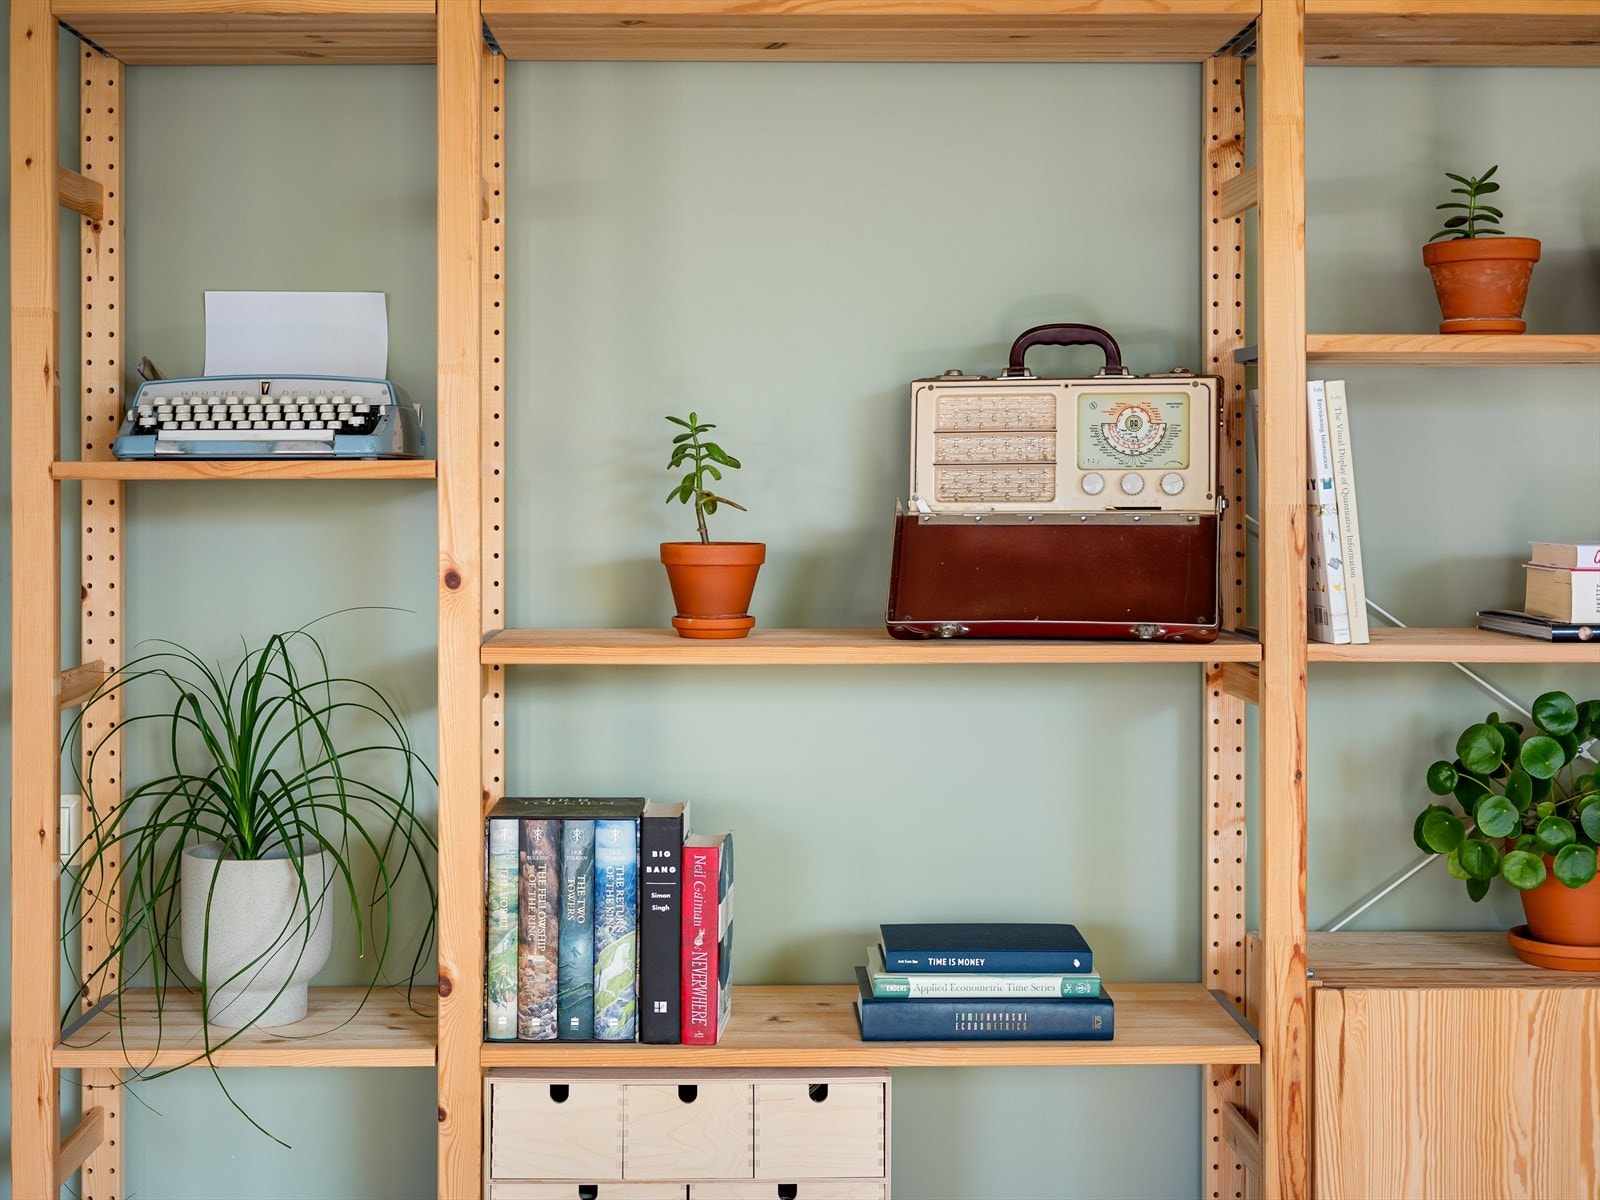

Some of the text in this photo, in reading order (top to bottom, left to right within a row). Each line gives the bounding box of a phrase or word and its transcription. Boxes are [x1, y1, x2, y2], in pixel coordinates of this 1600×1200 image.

[1335, 406, 1356, 578] The Visual Display of Quantitative Information
[528, 874, 536, 941] OF THE RING
[537, 863, 547, 952] THE FELLOWSHIP
[567, 877, 576, 921] TOWERS
[577, 873, 586, 924] THE TWO
[606, 866, 615, 933] OF THE KING
[616, 865, 625, 933] THE RETURN
[651, 904, 670, 912] Singh
[693, 854, 707, 927] Neil Gaiman
[692, 952, 708, 1027] NEVERWHERE
[886, 984, 907, 992] ENDERS
[913, 983, 1056, 994] Applied Econometric Time Series
[928, 957, 985, 966] TIME IS MONEY
[1064, 982, 1072, 994] 3e
